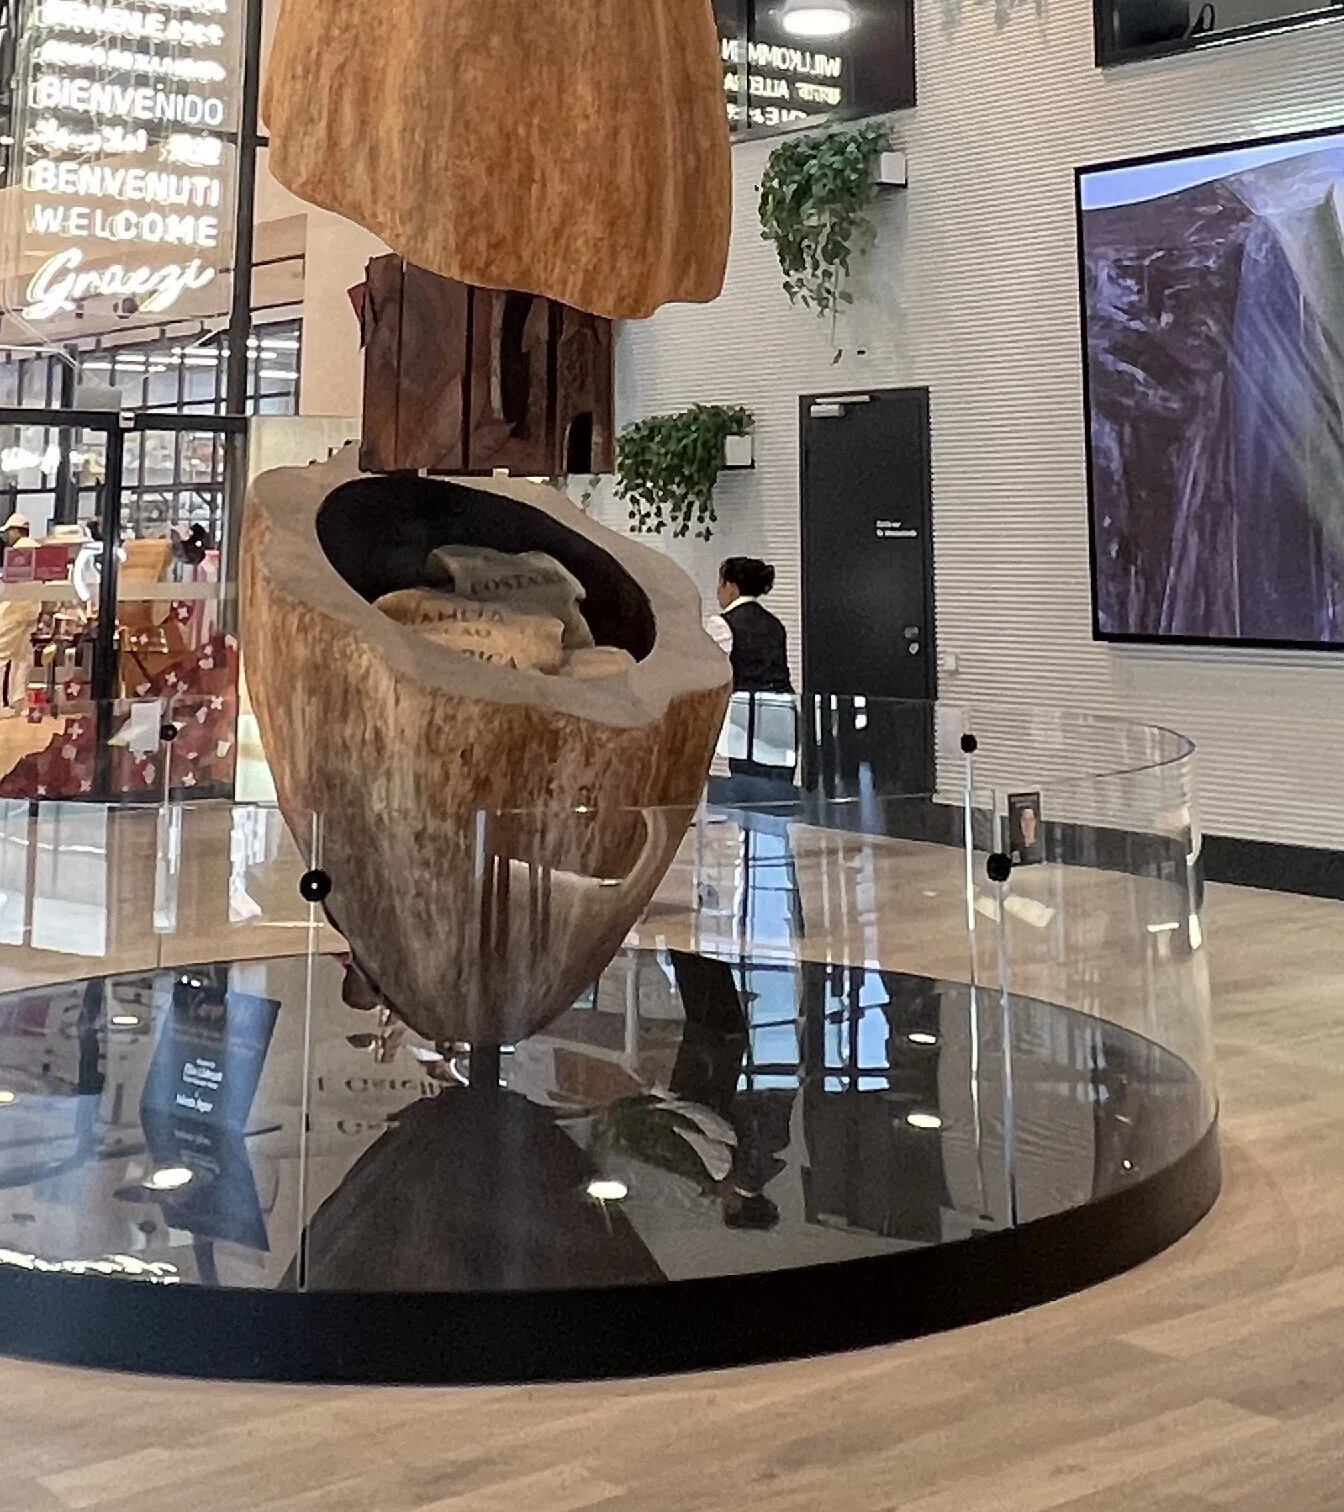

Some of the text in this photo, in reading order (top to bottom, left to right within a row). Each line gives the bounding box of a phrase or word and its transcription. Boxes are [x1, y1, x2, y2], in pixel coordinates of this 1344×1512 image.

[37, 75, 224, 126] BIENVENIDO
[34, 158, 220, 207] BENVENUTI
[34, 204, 218, 247] WELCOME
